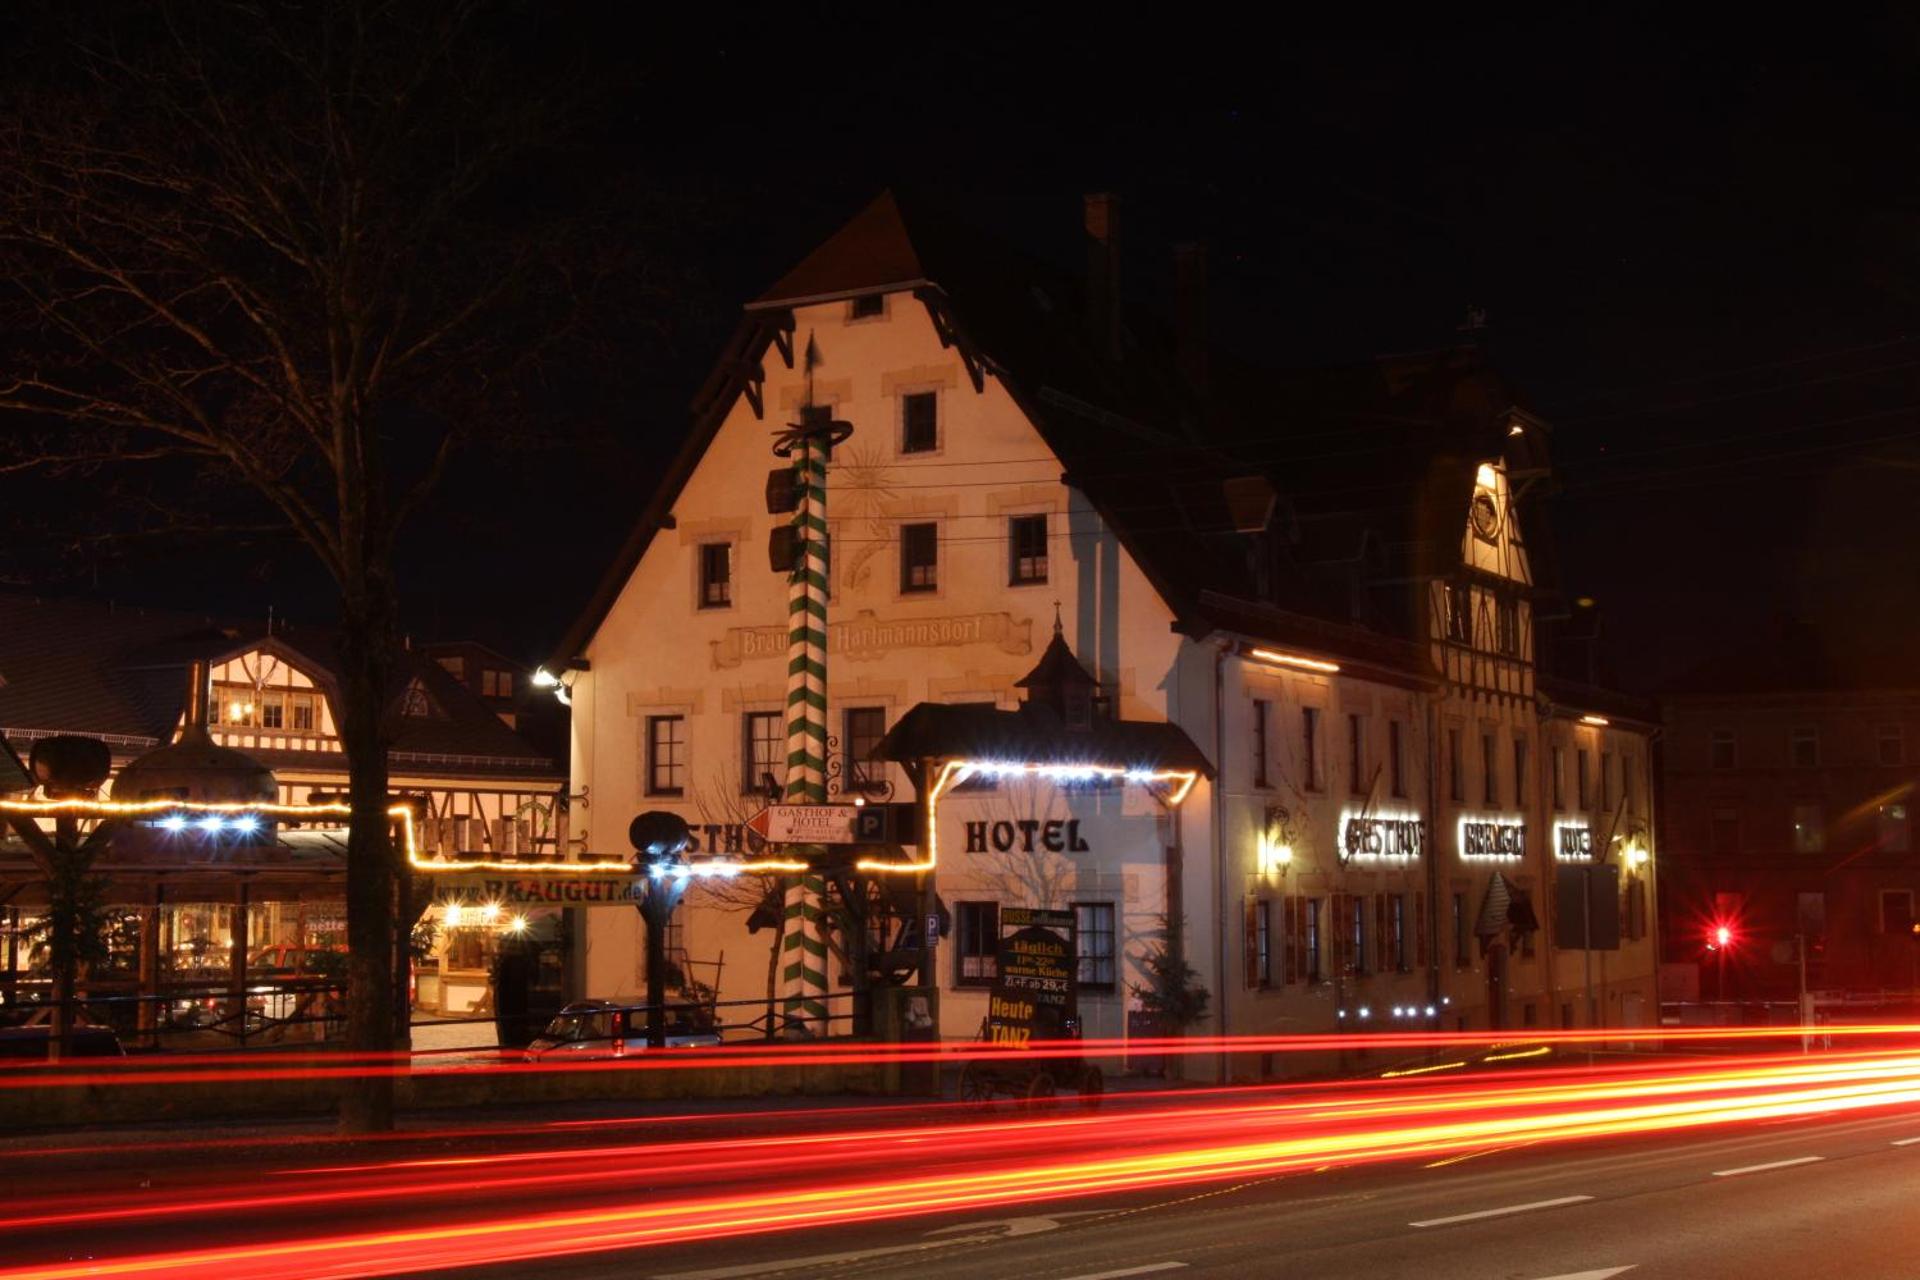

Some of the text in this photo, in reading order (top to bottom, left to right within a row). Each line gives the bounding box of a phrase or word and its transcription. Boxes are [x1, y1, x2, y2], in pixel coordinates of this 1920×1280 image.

[743, 631, 790, 656] Brau
[777, 808, 849, 818] GASTHOF &
[792, 817, 831, 826] HOTEL
[863, 815, 879, 835] P
[683, 821, 784, 856] STHO
[965, 819, 1090, 853] HOTEL
[928, 917, 937, 934] P
[991, 996, 1034, 1020] Heute
[991, 1024, 1032, 1050] TANZ
